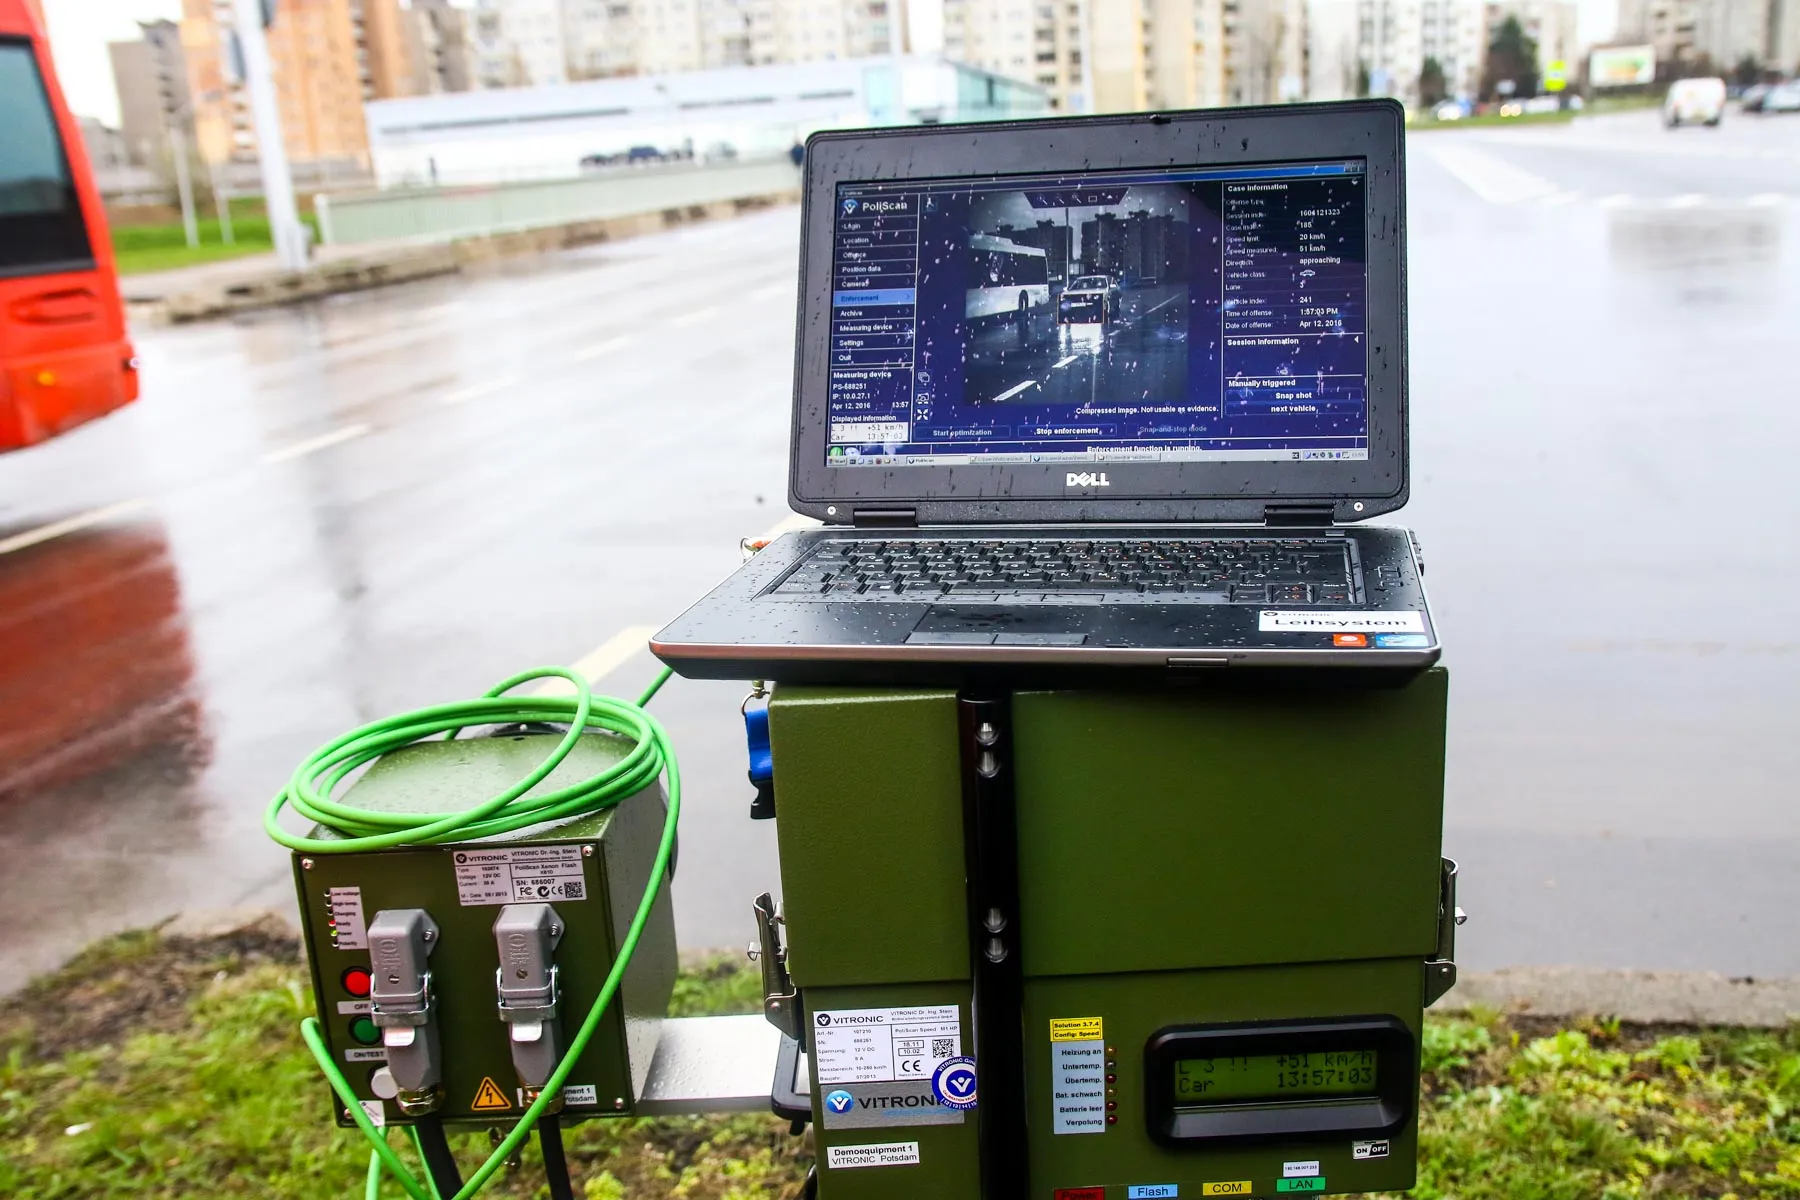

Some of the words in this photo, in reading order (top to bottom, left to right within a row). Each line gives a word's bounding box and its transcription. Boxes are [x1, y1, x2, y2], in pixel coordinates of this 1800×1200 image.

[863, 201, 908, 212] PoliScan
[1300, 257, 1341, 265] approaching
[1300, 320, 1312, 329] Apr
[1325, 319, 1342, 327] 2016
[839, 340, 864, 348] Settings
[1258, 337, 1299, 346] information
[833, 372, 868, 380] Measuring
[1228, 380, 1261, 389] Manually
[1262, 379, 1296, 388] triggered
[1275, 392, 1295, 401] Snap
[831, 403, 843, 411] Apr
[1075, 407, 1117, 416] Compressed
[1154, 405, 1176, 413] usable
[1187, 405, 1219, 413] evidence.
[1271, 405, 1288, 413] next
[1289, 405, 1317, 413] vehicle
[831, 415, 862, 423] Displayed
[884, 423, 904, 431] km/h
[1036, 427, 1053, 436] Stop
[1054, 427, 1099, 435] enforcement
[831, 433, 846, 441] Car
[932, 429, 950, 437] Start
[950, 429, 993, 438] optimization
[1066, 471, 1110, 487] DELL
[833, 1015, 884, 1024] VITRONIC
[1276, 1053, 1311, 1069] +51
[1324, 1050, 1373, 1068] km/h
[937, 1057, 964, 1072] VITRONIC
[1065, 1076, 1102, 1084] Übertemp.
[1178, 1077, 1215, 1094] Car
[1277, 1067, 1373, 1089] 13:57:03
[858, 1095, 940, 1110] VITRON
[834, 1145, 906, 1157] Demoequipment
[907, 1144, 913, 1153] 1
[831, 1155, 876, 1166] VITRONIC
[880, 1153, 917, 1162] Potsdam
[1212, 1183, 1242, 1193] COM
[1289, 1179, 1313, 1190] LAN
[1137, 1187, 1169, 1197] Flash
